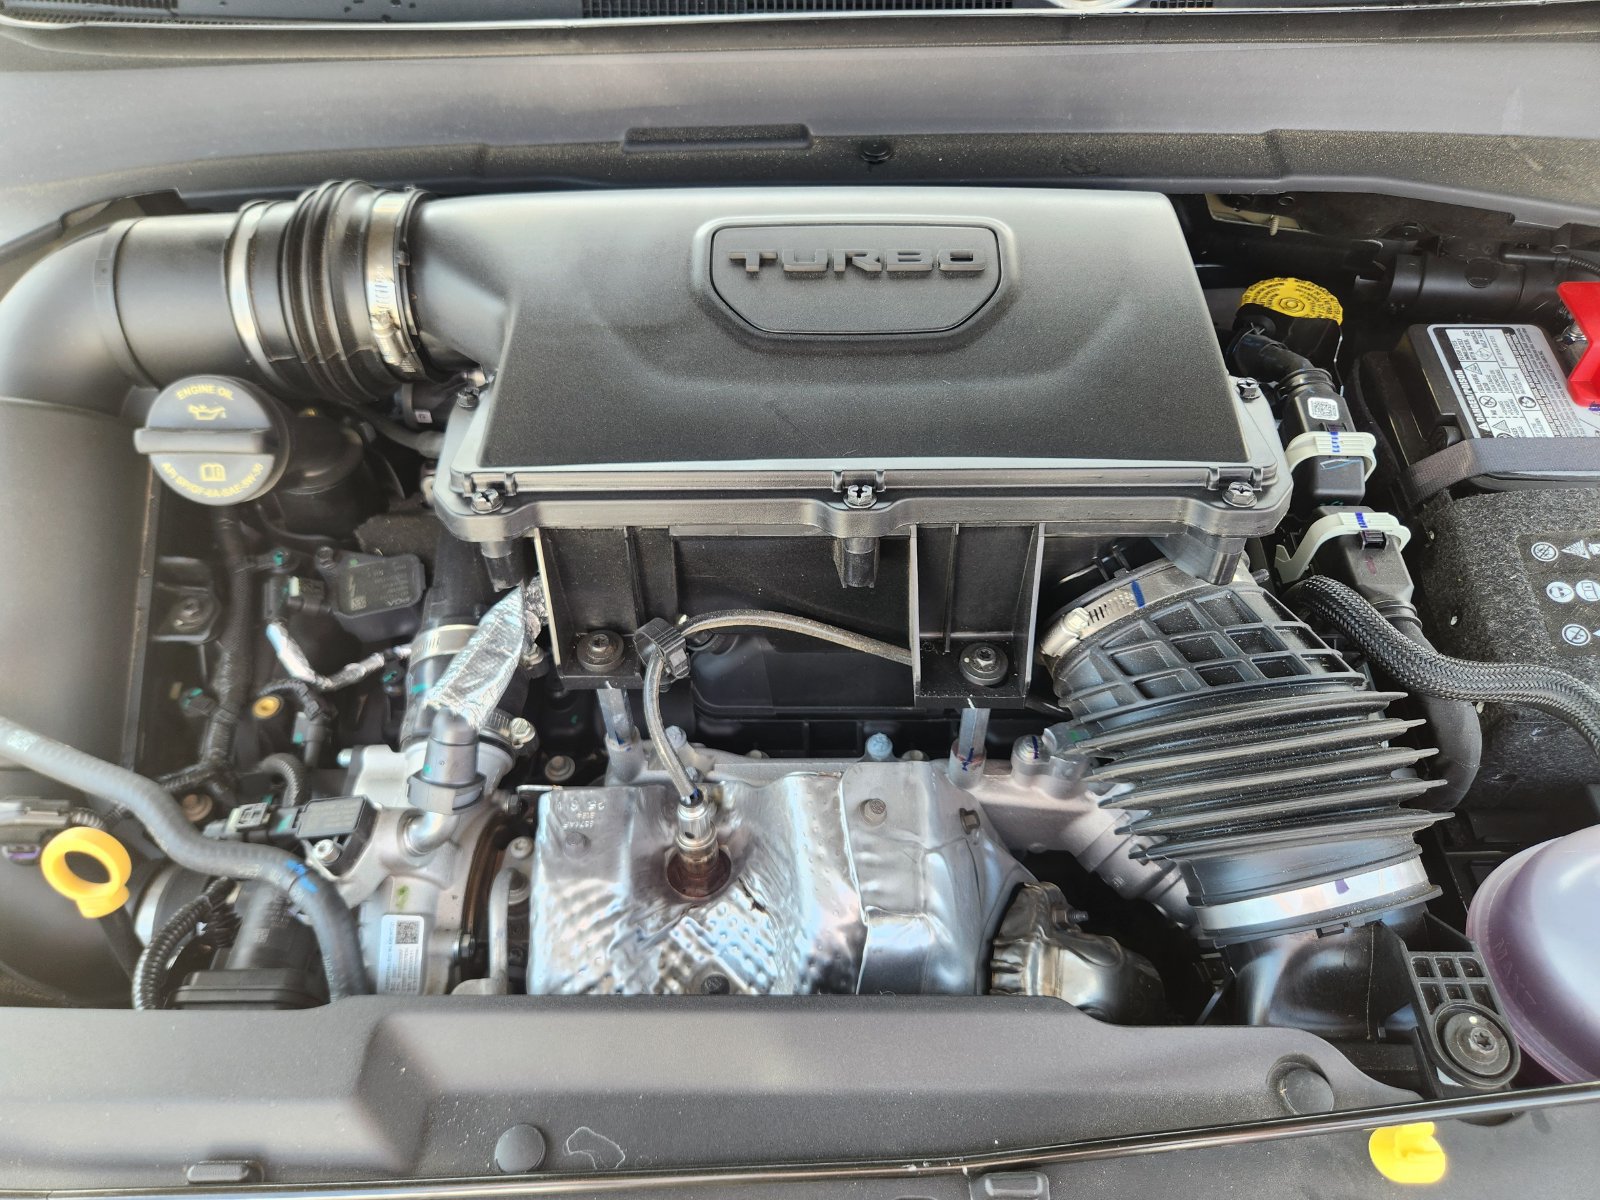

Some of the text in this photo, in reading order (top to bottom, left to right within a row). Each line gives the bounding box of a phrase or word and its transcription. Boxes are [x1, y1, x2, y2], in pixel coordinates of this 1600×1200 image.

[728, 248, 987, 274] TURBO
[176, 384, 234, 400] ENGINE OIL
[1454, 370, 1486, 422] DANGER/POISON
